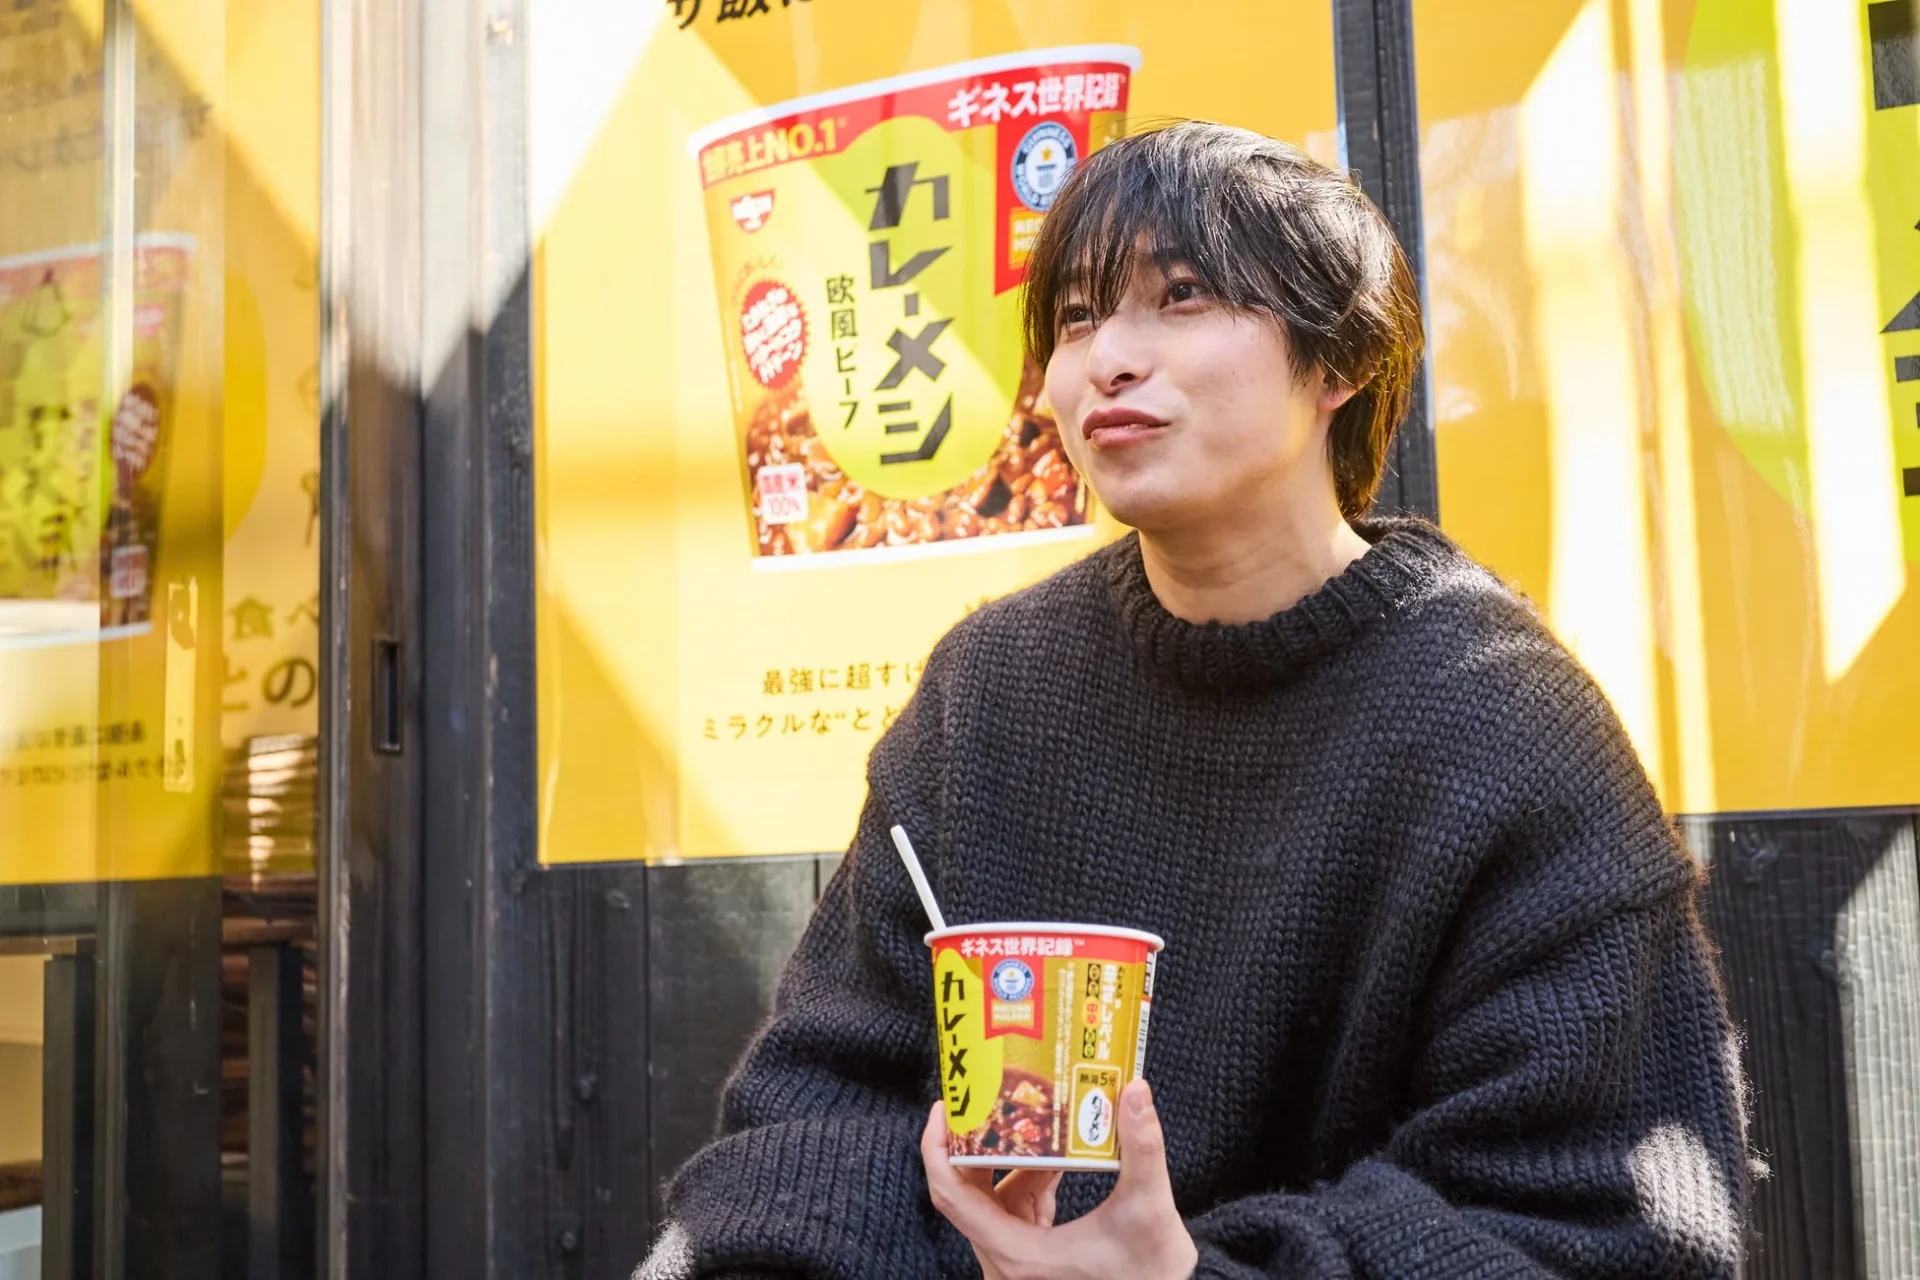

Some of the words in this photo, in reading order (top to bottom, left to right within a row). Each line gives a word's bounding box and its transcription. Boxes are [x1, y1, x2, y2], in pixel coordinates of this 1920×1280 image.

[826, 274, 858, 429] 欧風ビーフ
[865, 161, 954, 465] カレーメシ
[941, 971, 970, 1117] カレーメシ
